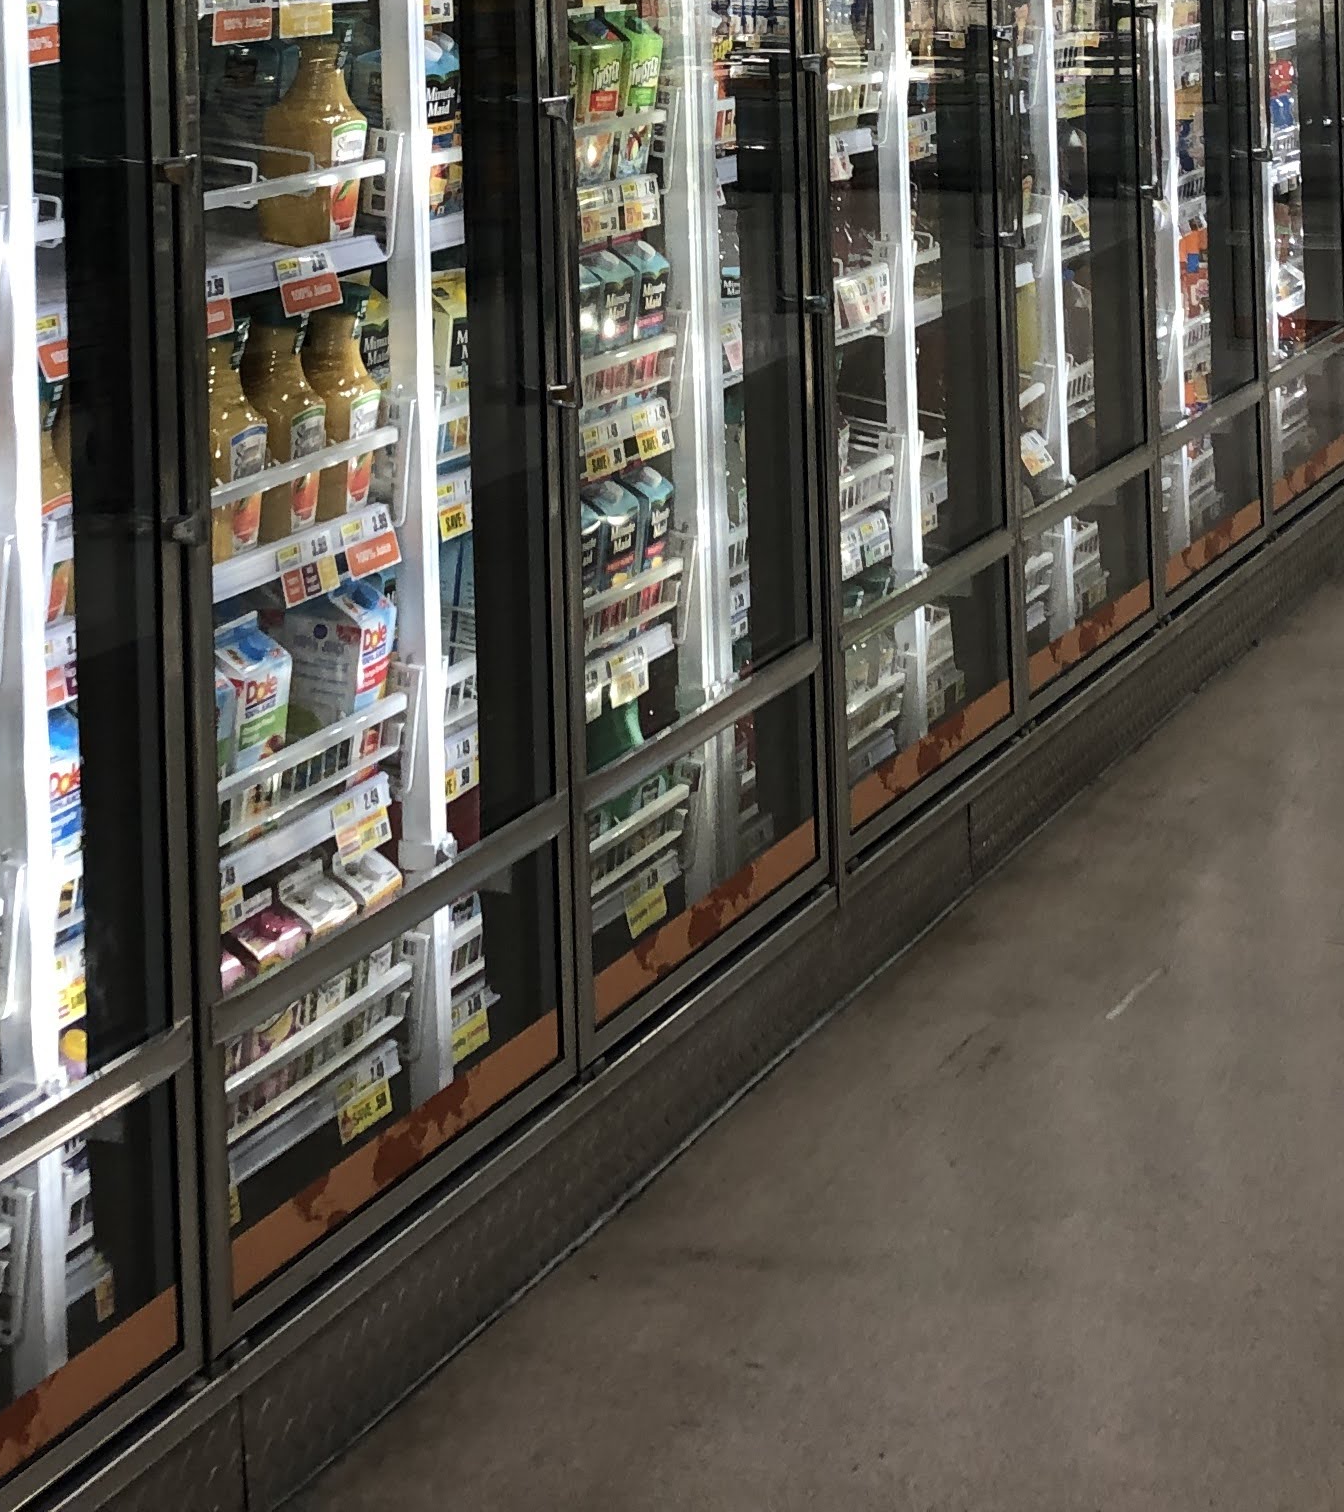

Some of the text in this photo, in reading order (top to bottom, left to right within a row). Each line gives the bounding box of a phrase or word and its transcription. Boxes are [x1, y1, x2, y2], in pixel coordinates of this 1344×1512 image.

[426, 86, 456, 102] Minute
[428, 102, 451, 117] Maid
[362, 621, 387, 651] Dole
[246, 673, 278, 705] Dole
